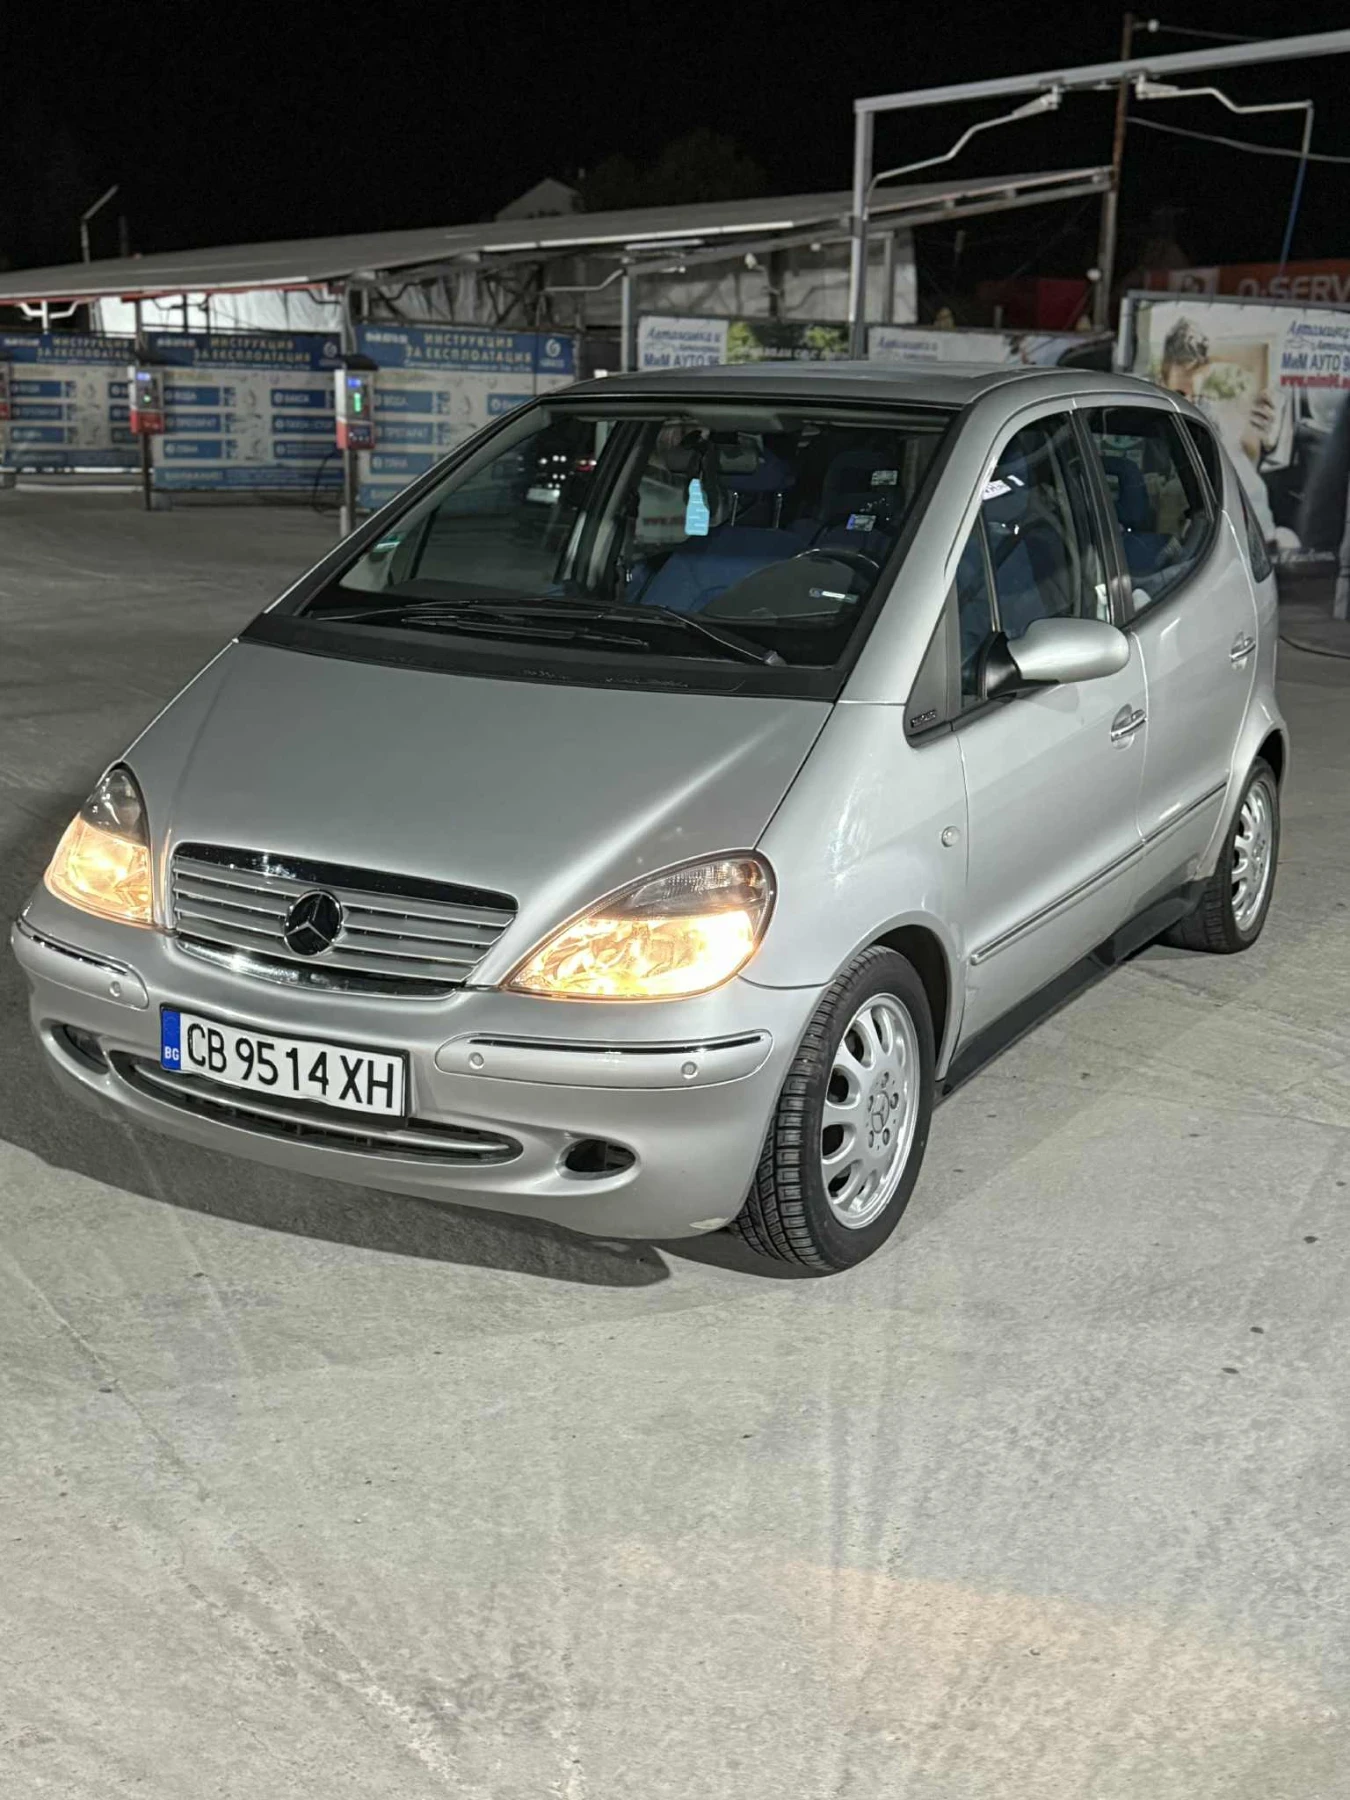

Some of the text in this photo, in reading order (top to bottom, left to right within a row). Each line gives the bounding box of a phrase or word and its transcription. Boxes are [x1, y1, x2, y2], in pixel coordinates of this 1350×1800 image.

[424, 332, 514, 349] ИНСТРУКЦИЯ
[426, 347, 532, 364] ЕКСПЛОАТАЦИЯ
[164, 1046, 180, 1061] BG
[187, 1023, 394, 1109] CB 9514 XH
